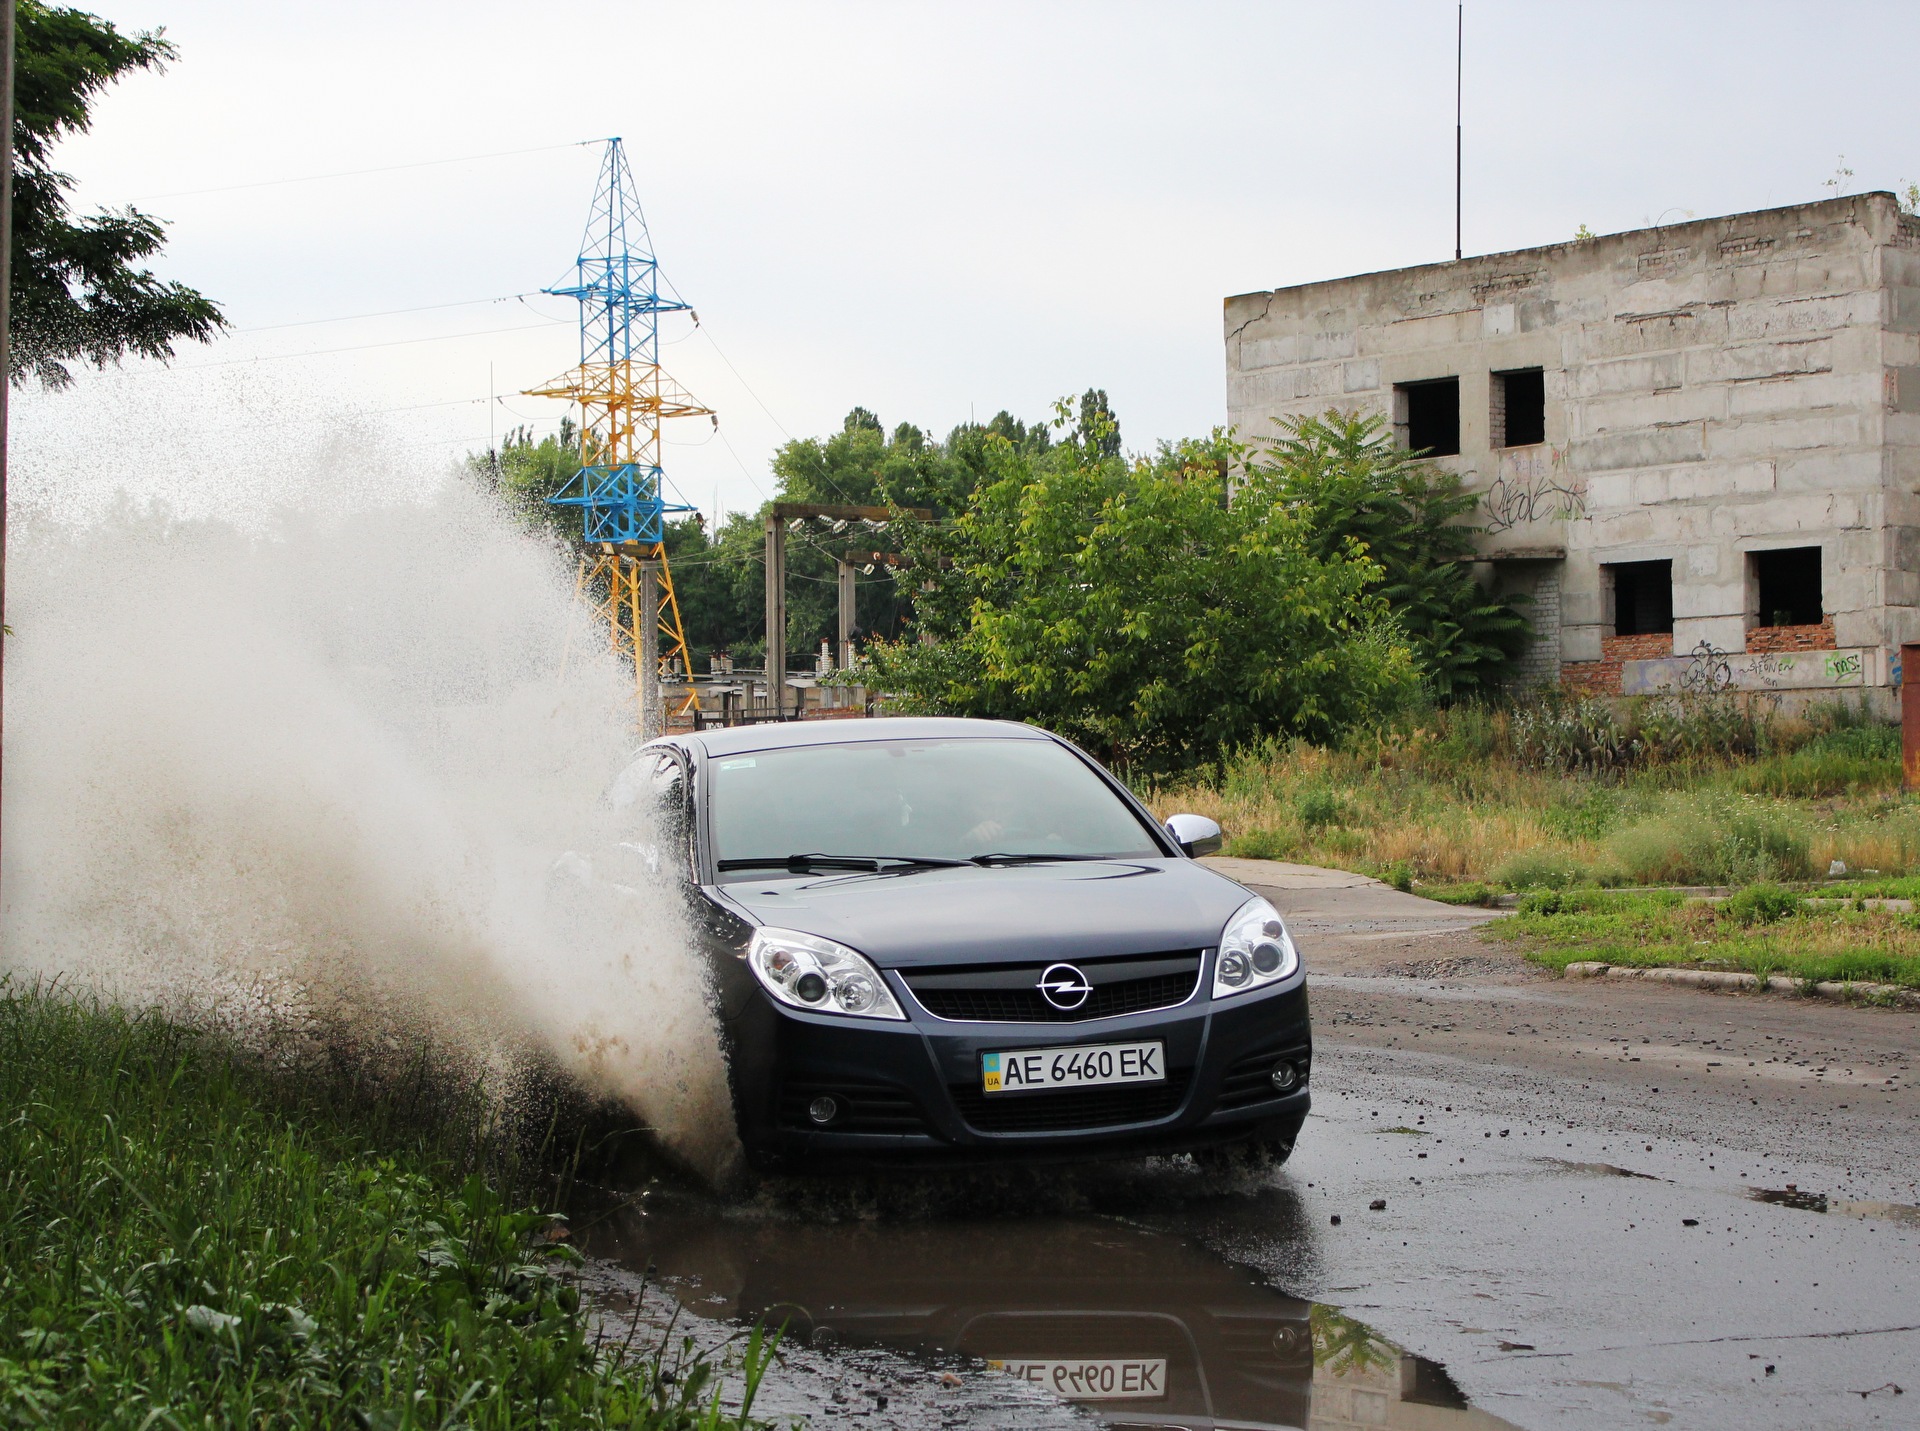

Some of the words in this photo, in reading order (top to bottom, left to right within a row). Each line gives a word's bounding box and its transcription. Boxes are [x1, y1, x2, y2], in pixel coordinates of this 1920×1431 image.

[1004, 1055, 1045, 1086] AE
[1050, 1050, 1114, 1082] 6460
[1120, 1047, 1159, 1077] EK
[987, 1077, 1000, 1086] UA
